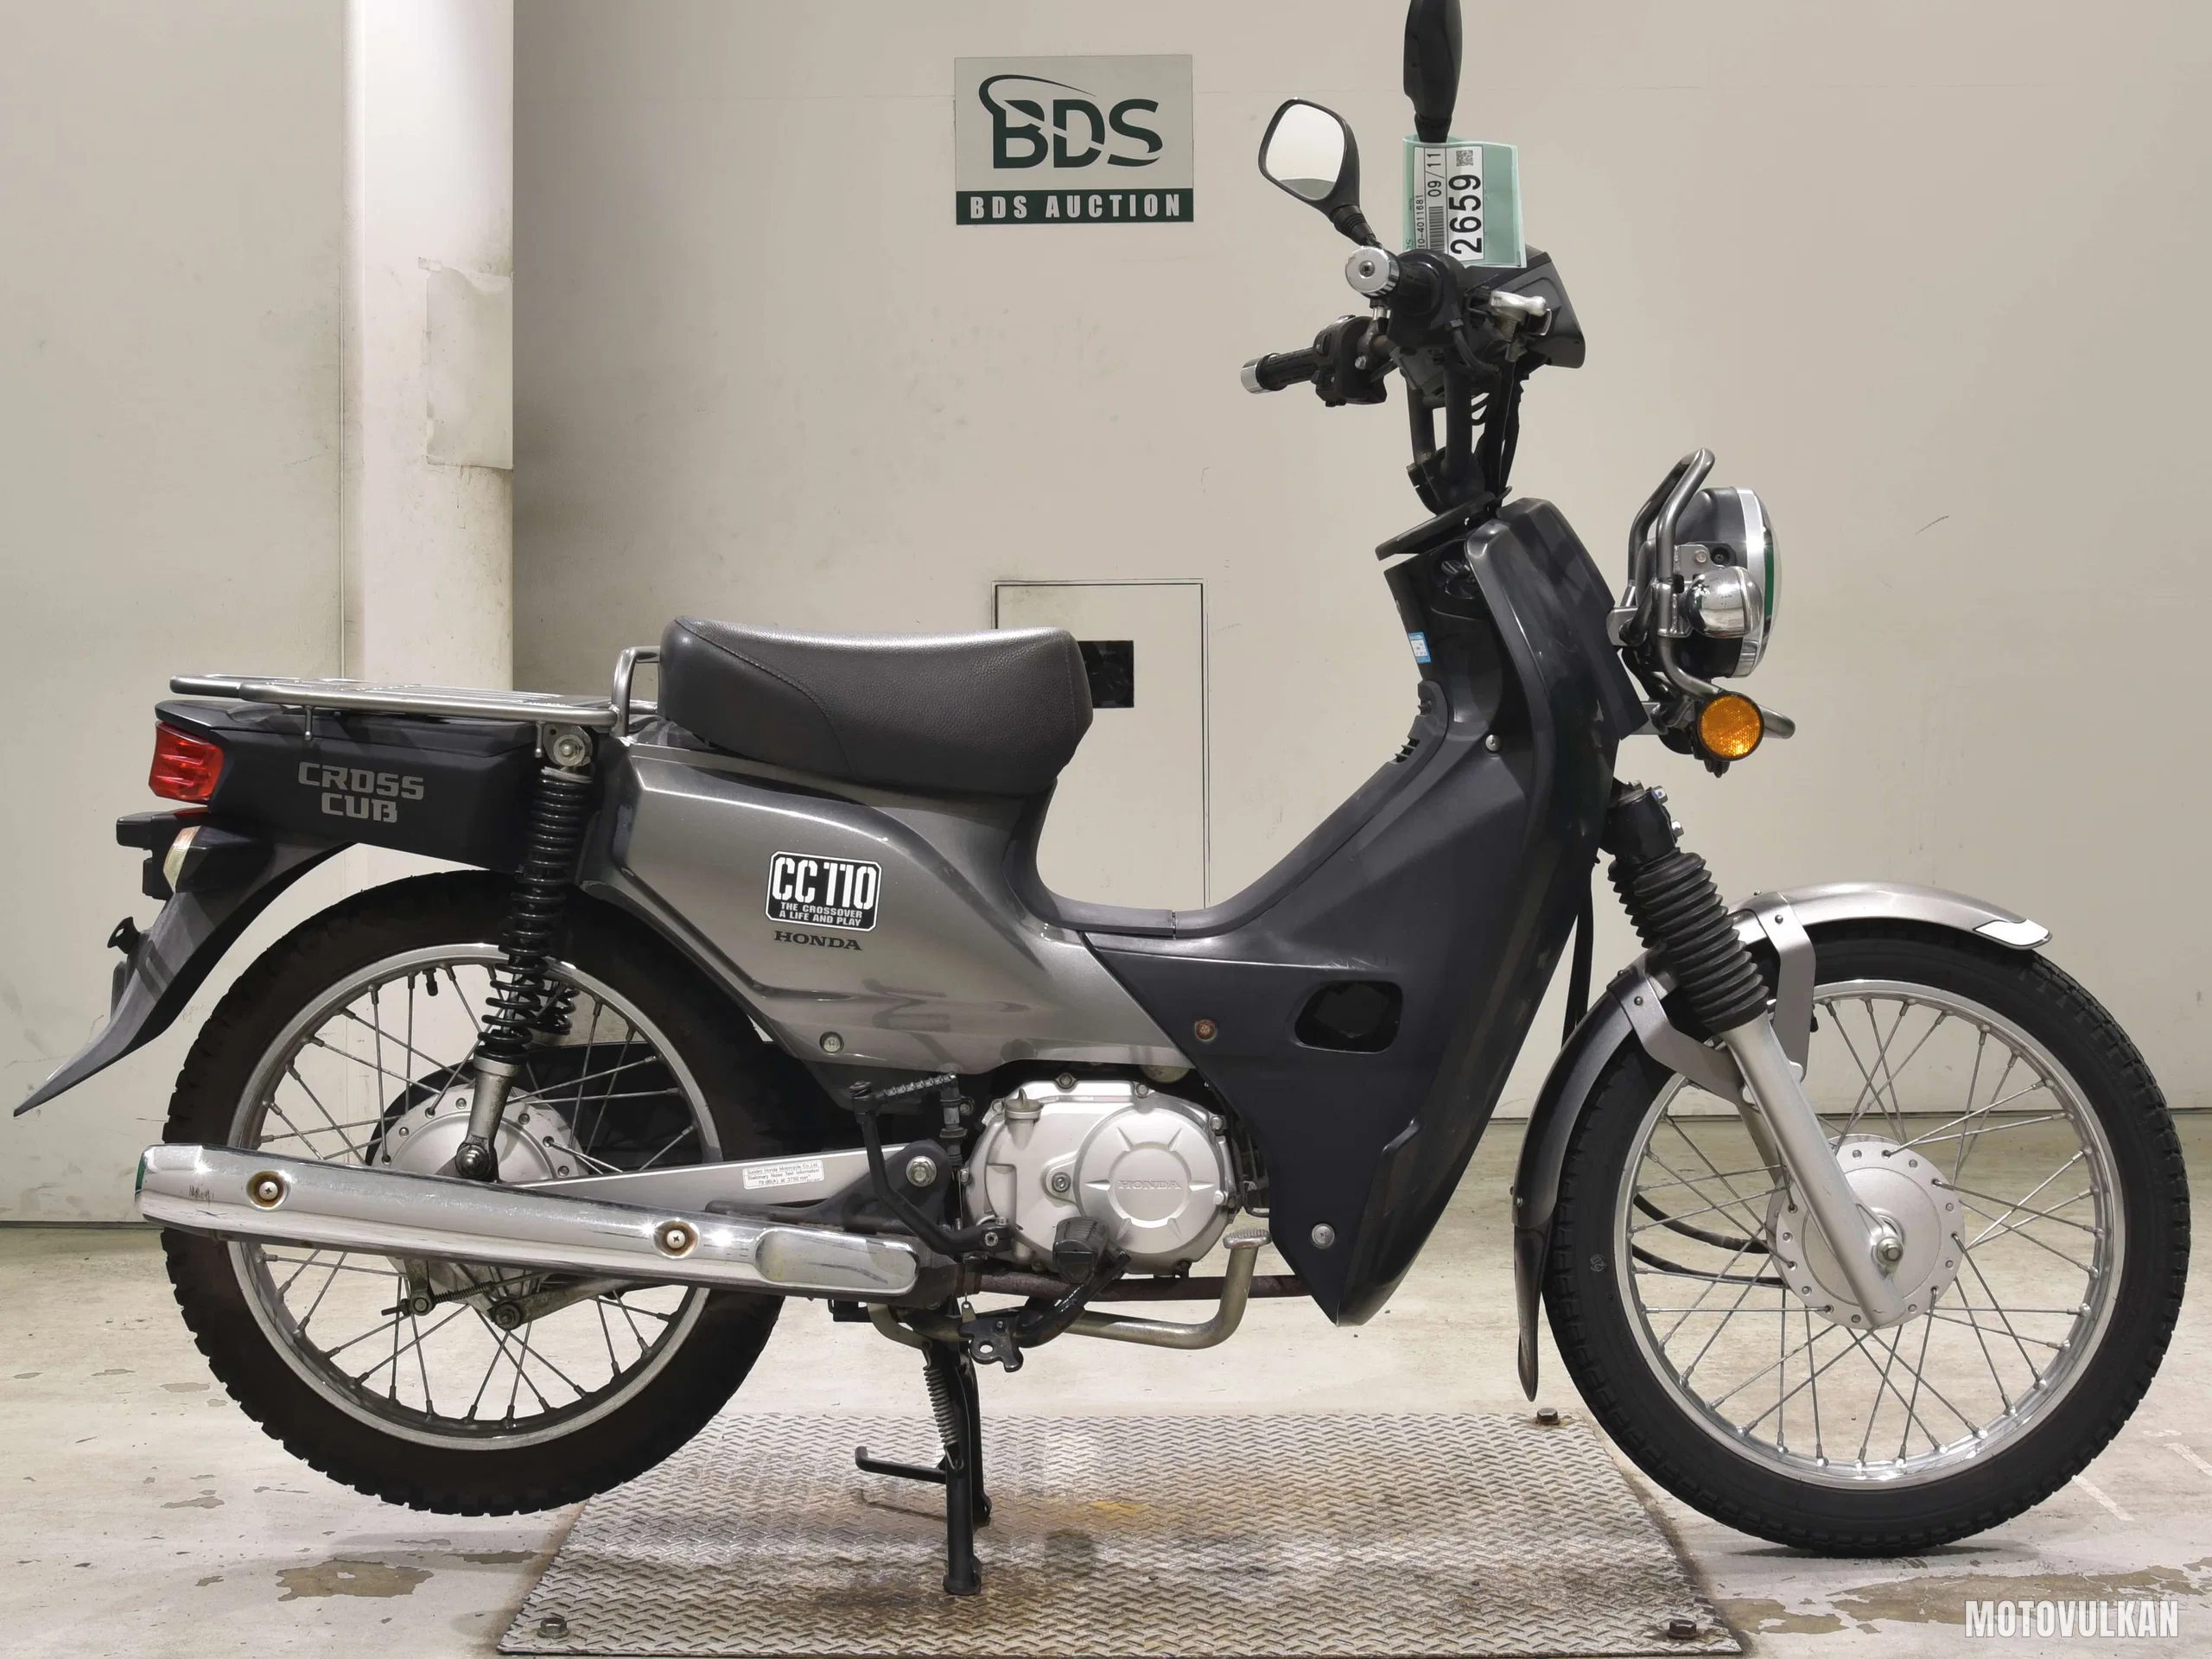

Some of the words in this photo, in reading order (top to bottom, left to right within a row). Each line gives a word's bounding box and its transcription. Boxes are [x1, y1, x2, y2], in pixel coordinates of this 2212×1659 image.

[979, 74, 1163, 168] BDS
[1426, 152, 1445, 197] 09/11
[970, 195, 1027, 219] BDS
[1046, 194, 1179, 218] AUCTION
[1448, 175, 1482, 254] 2659
[298, 761, 424, 800] CROSS
[321, 792, 397, 823] CUB
[772, 857, 818, 903] CC
[823, 862, 877, 910] 110
[780, 901, 798, 912] THE
[802, 904, 862, 918] CROSSOVER
[789, 912, 810, 921] LIFE
[812, 914, 833, 924] AND
[836, 918, 861, 926] PLAY
[773, 931, 862, 950] HONDA
[1118, 1179, 1181, 1190] HONDA
